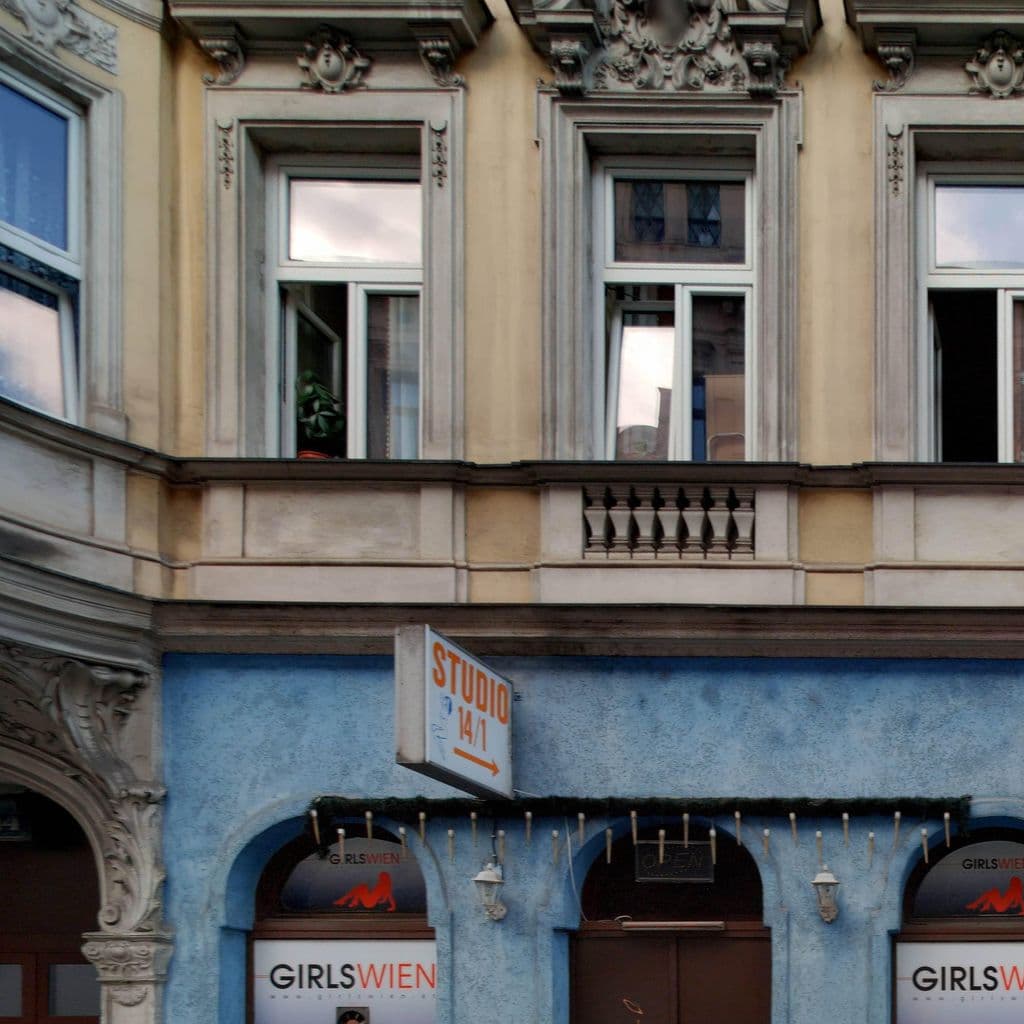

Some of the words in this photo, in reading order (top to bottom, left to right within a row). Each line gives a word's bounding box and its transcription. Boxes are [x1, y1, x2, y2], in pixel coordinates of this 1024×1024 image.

[432, 641, 509, 725] STUDIO
[458, 706, 487, 752] 14/1
[329, 853, 400, 865] GRLSWIEN
[270, 963, 436, 989] GIRLSWIEN
